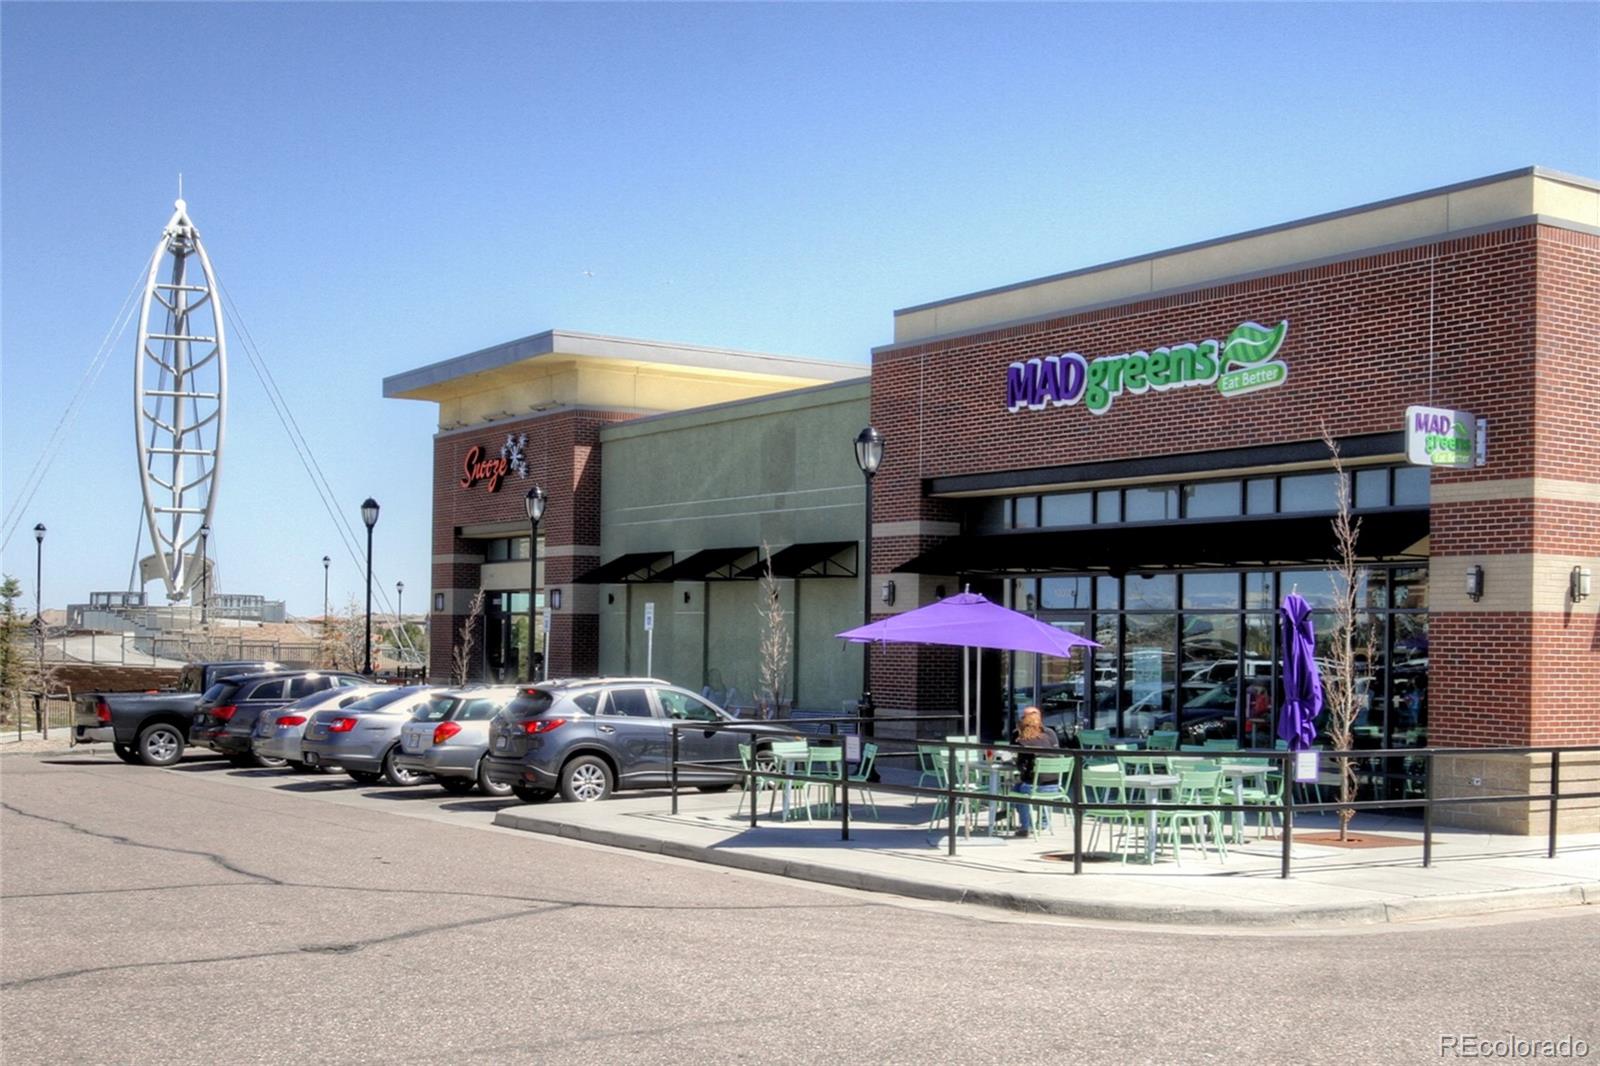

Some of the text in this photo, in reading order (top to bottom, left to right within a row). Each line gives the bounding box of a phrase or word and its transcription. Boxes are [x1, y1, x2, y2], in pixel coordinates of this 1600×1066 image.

[1222, 368, 1279, 390] Eat Better
[1415, 412, 1450, 436] MAD
